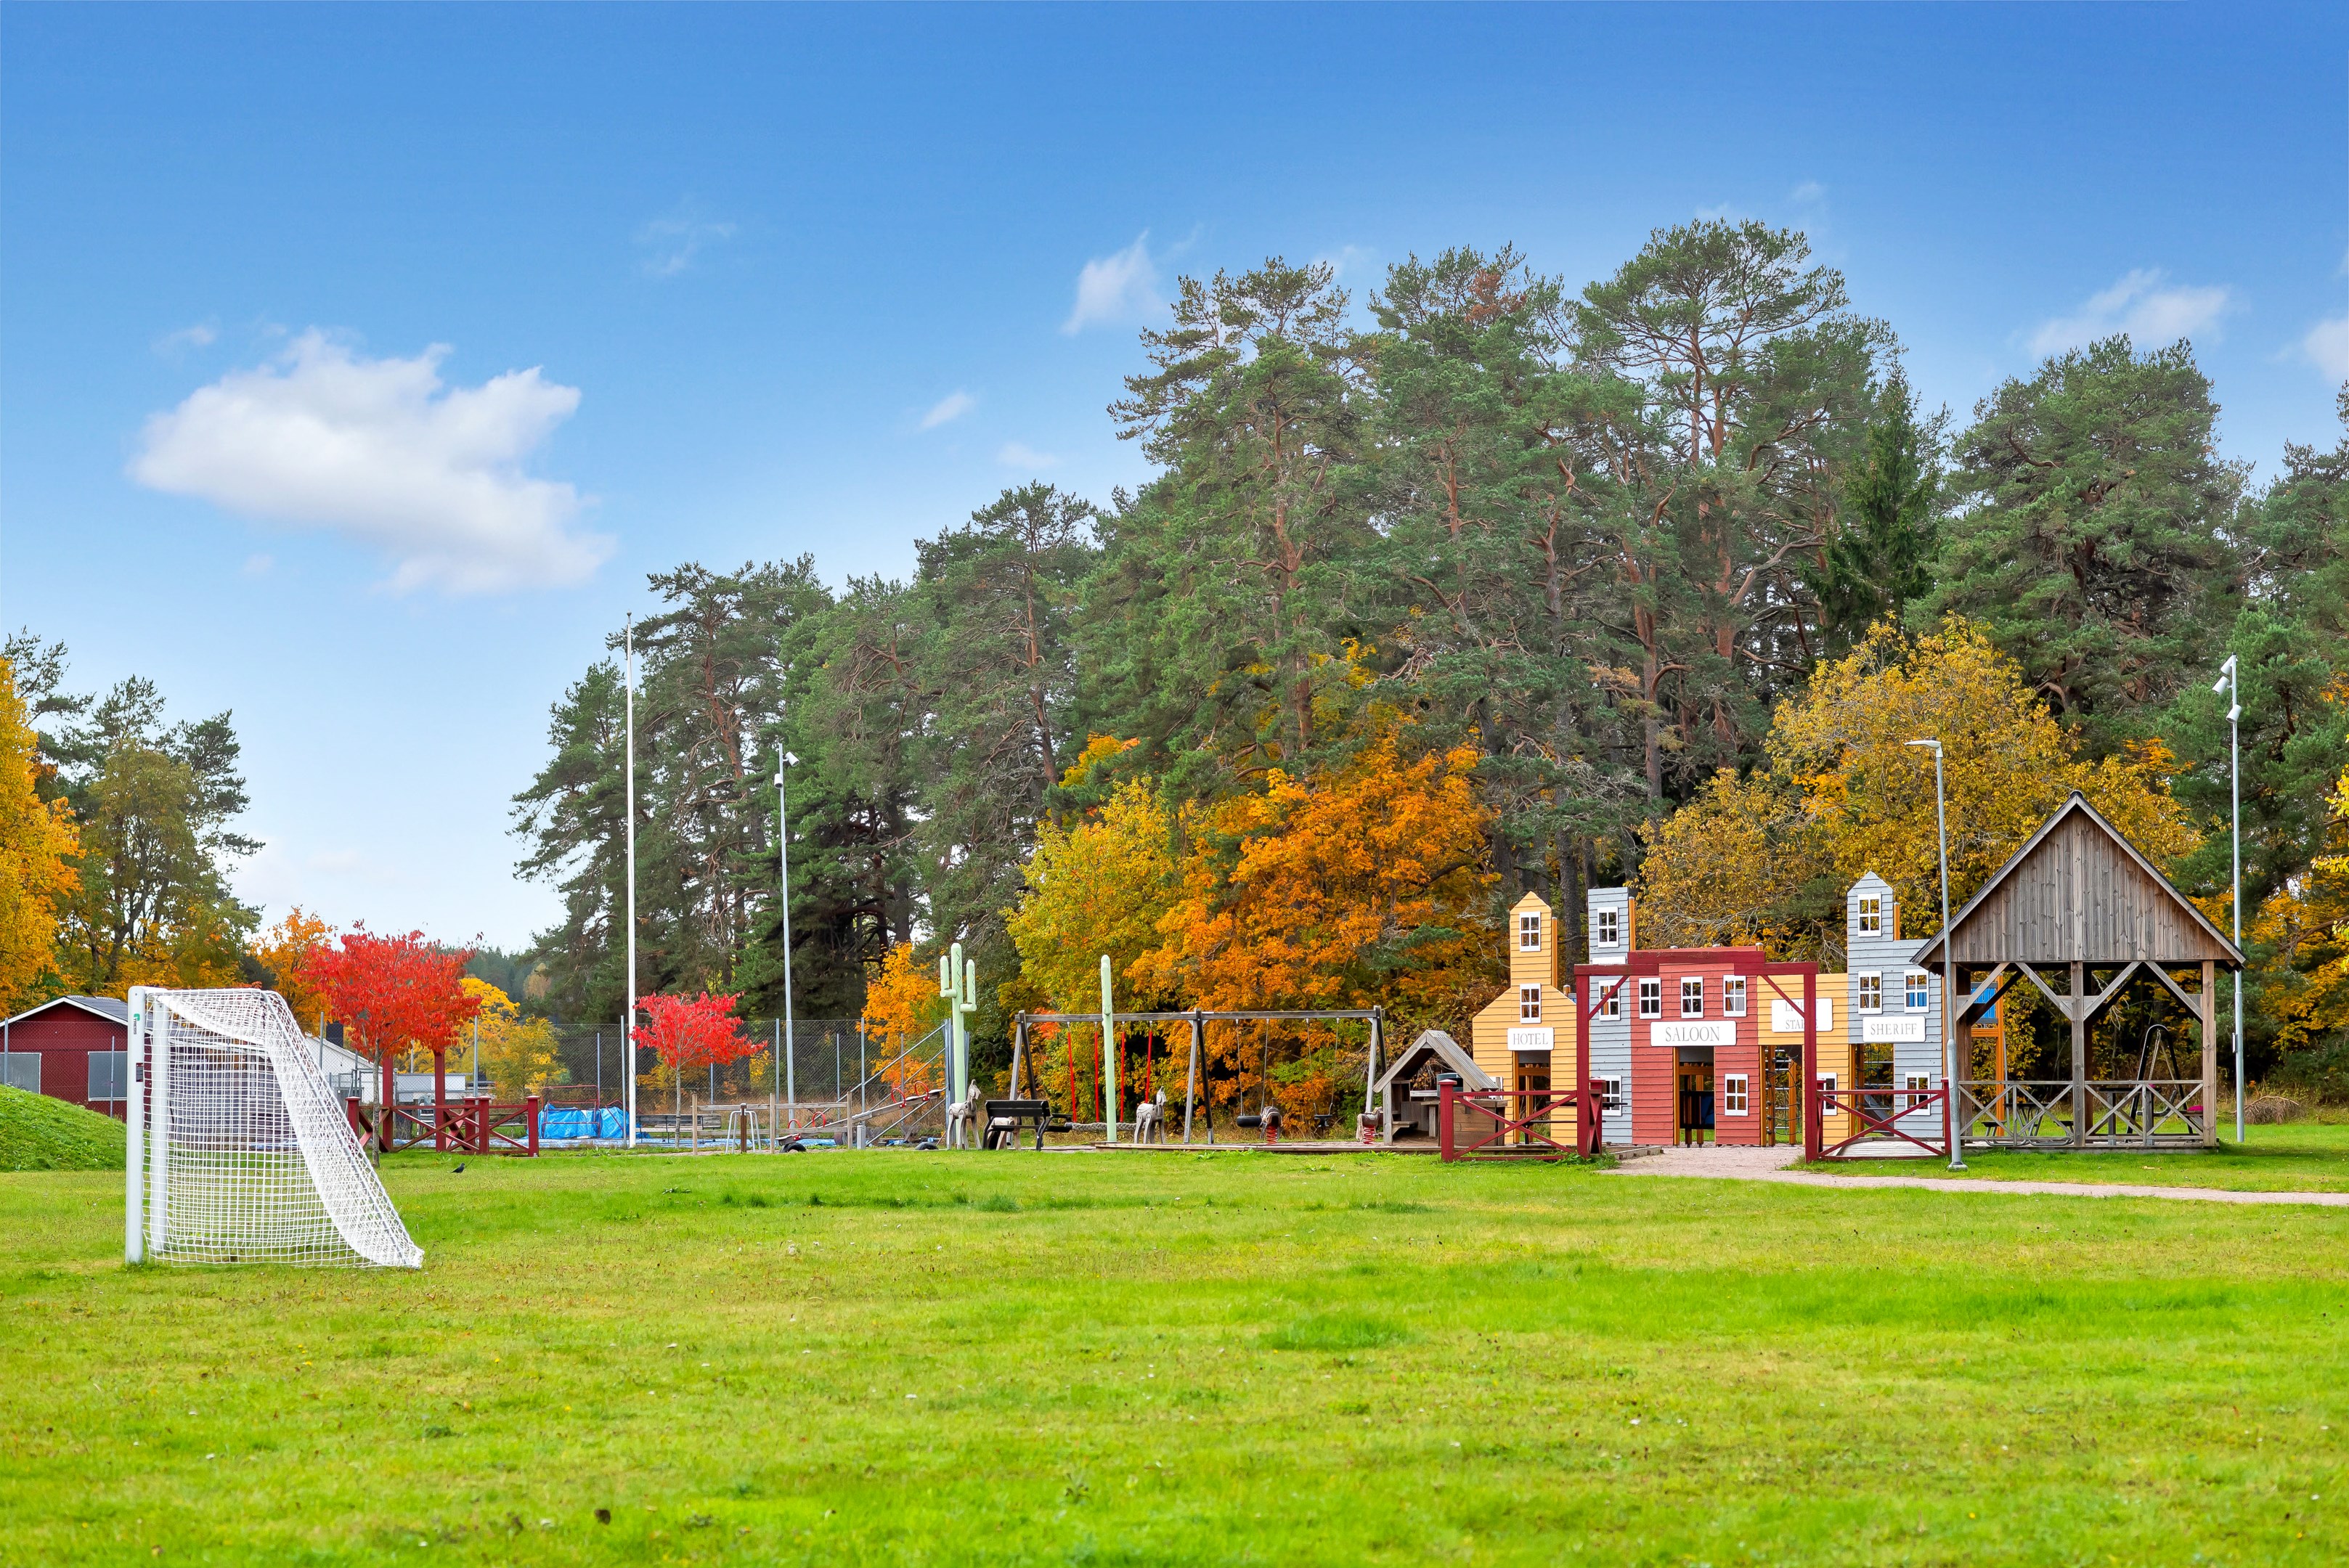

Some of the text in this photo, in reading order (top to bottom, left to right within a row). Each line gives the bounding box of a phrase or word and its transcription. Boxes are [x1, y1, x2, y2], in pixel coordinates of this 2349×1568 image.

[1786, 1019, 1818, 1029] STA
[1870, 1024, 1917, 1035] SHERIFF
[1513, 1033, 1548, 1045] HOTEL
[1665, 1026, 1719, 1042] SALOON
